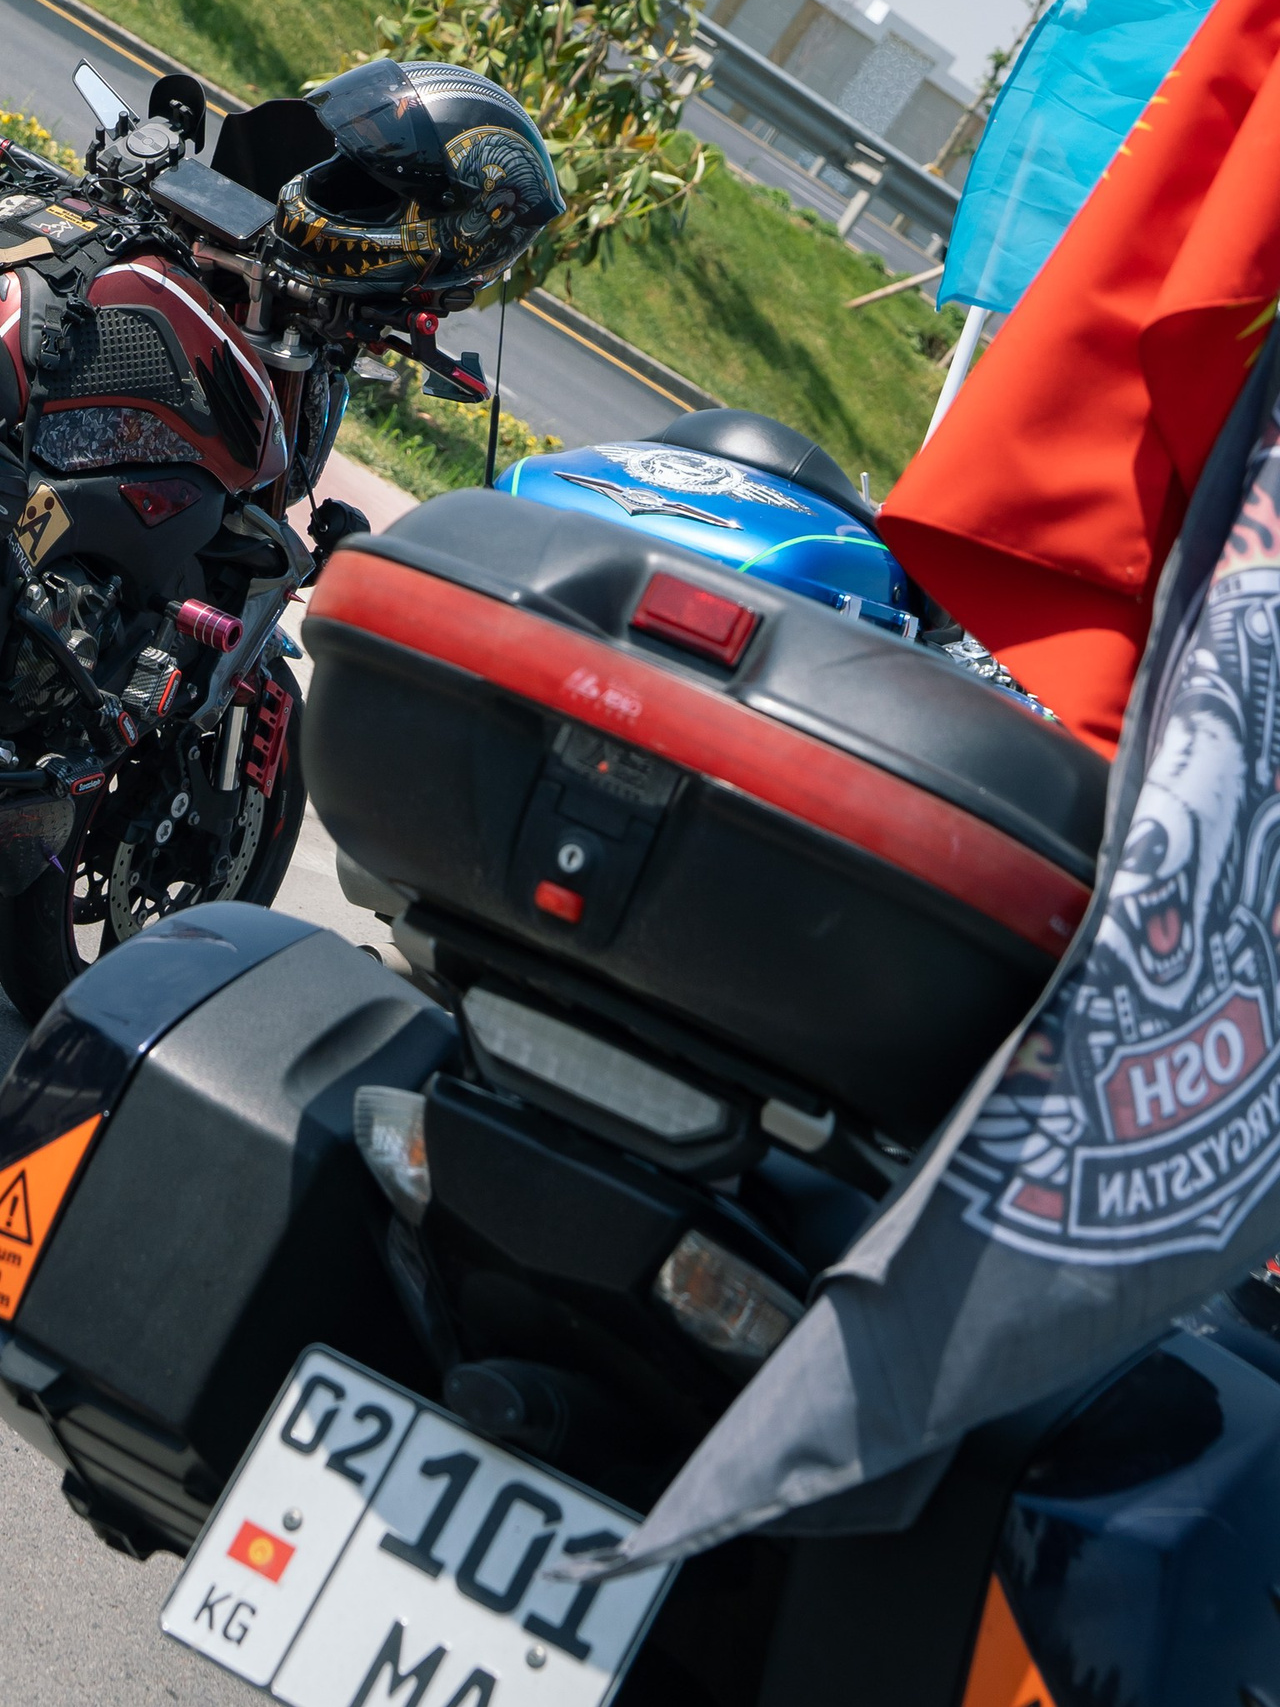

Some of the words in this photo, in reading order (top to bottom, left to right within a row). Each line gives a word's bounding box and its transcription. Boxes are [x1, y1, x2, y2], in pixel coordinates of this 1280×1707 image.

[6, 532, 34, 577] A-STYLE
[279, 1373, 394, 1488] 02
[379, 1449, 626, 1662] 101
[193, 1583, 257, 1647] KG
